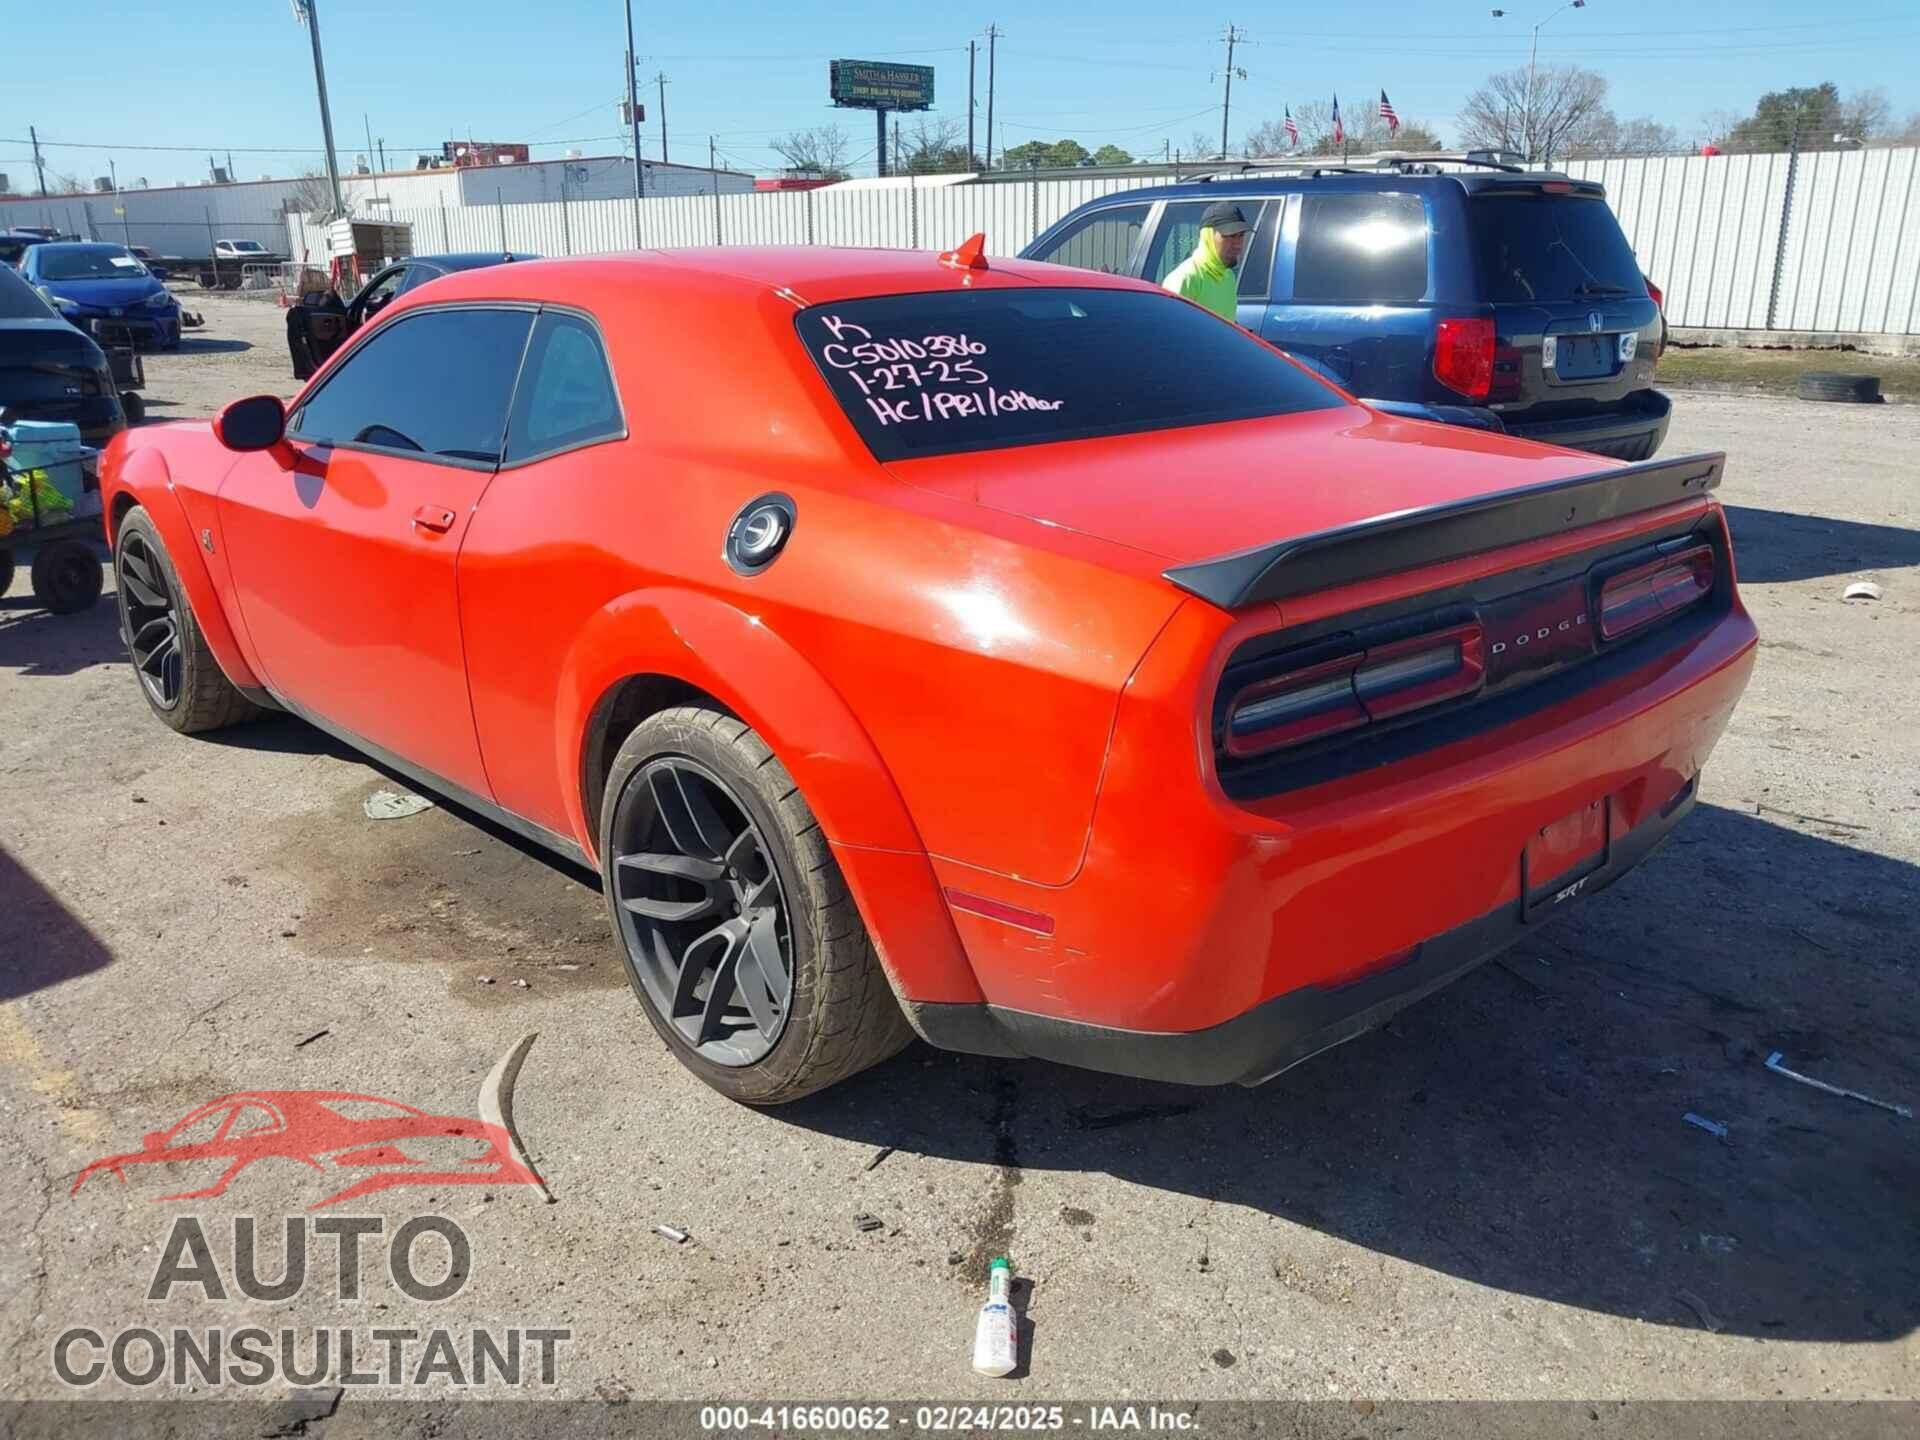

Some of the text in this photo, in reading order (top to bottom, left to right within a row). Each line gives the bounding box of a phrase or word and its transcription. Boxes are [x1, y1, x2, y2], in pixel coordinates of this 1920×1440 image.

[854, 68, 880, 80] SMITH
[849, 360, 989, 395] 1-27-25
[1492, 613, 1586, 654] DODGE
[1554, 876, 1588, 904] SRT
